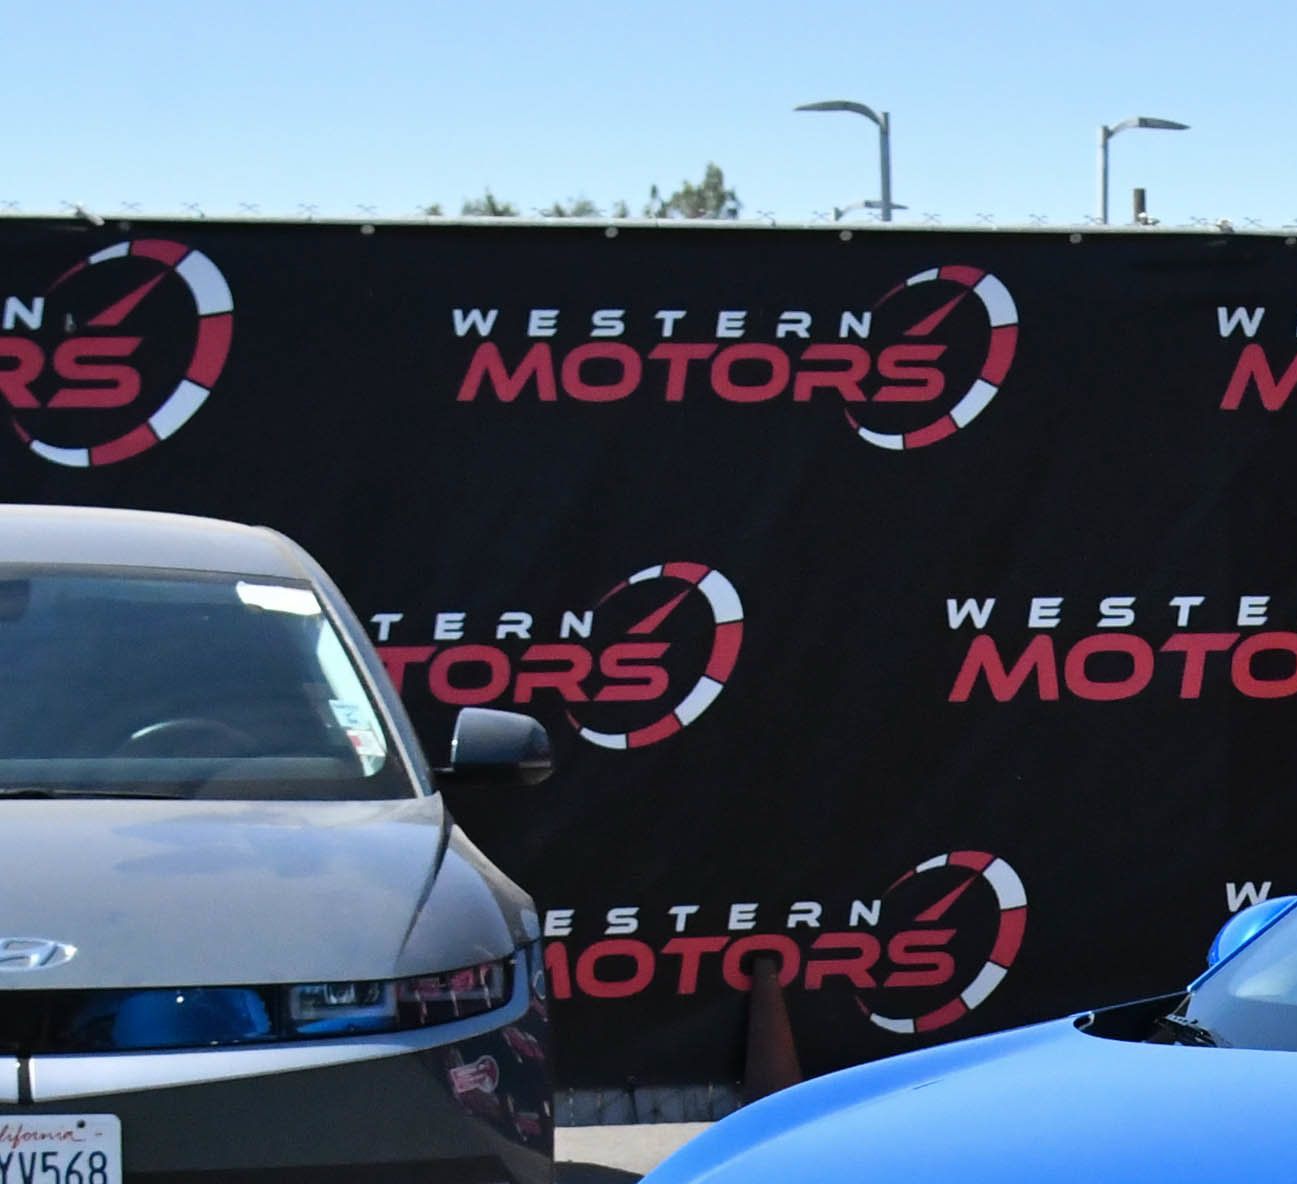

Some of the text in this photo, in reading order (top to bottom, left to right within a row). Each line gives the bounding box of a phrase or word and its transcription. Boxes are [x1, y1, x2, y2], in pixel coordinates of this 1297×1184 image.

[453, 309, 872, 338] WESTERN
[457, 342, 947, 403] MOTORS
[370, 610, 595, 642] TERN
[376, 642, 669, 705] TORS
[543, 899, 882, 937] ESTERN
[0, 1124, 86, 1150] lifornia
